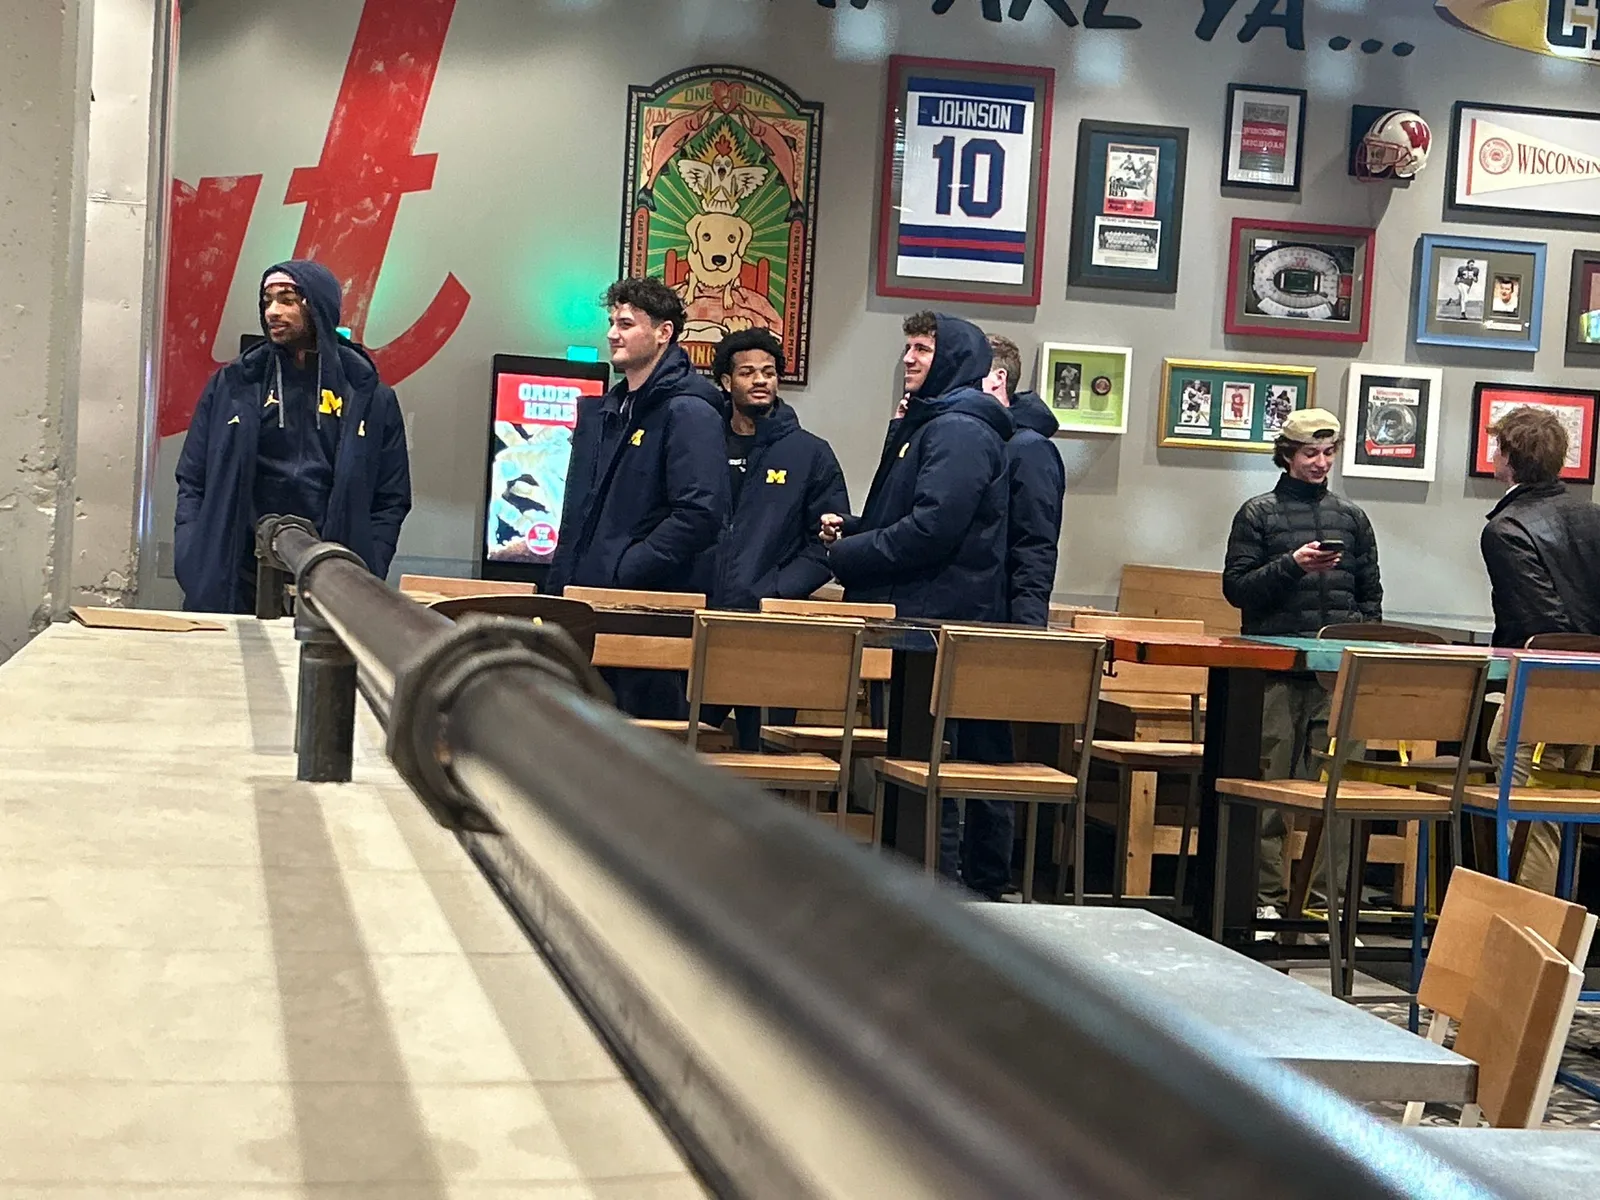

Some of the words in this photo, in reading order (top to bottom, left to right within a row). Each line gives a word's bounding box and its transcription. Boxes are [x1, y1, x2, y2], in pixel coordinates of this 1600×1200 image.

[684, 87, 713, 104] ONE
[734, 88, 772, 110] LOVE
[931, 99, 1013, 131] JOHNSON
[1399, 120, 1431, 155] W
[1517, 143, 1600, 176] WISCONSIN
[932, 135, 1006, 219] 10
[318, 388, 343, 418] M
[518, 383, 581, 404] ORDER
[522, 402, 577, 422] HERE
[765, 468, 787, 485] M
